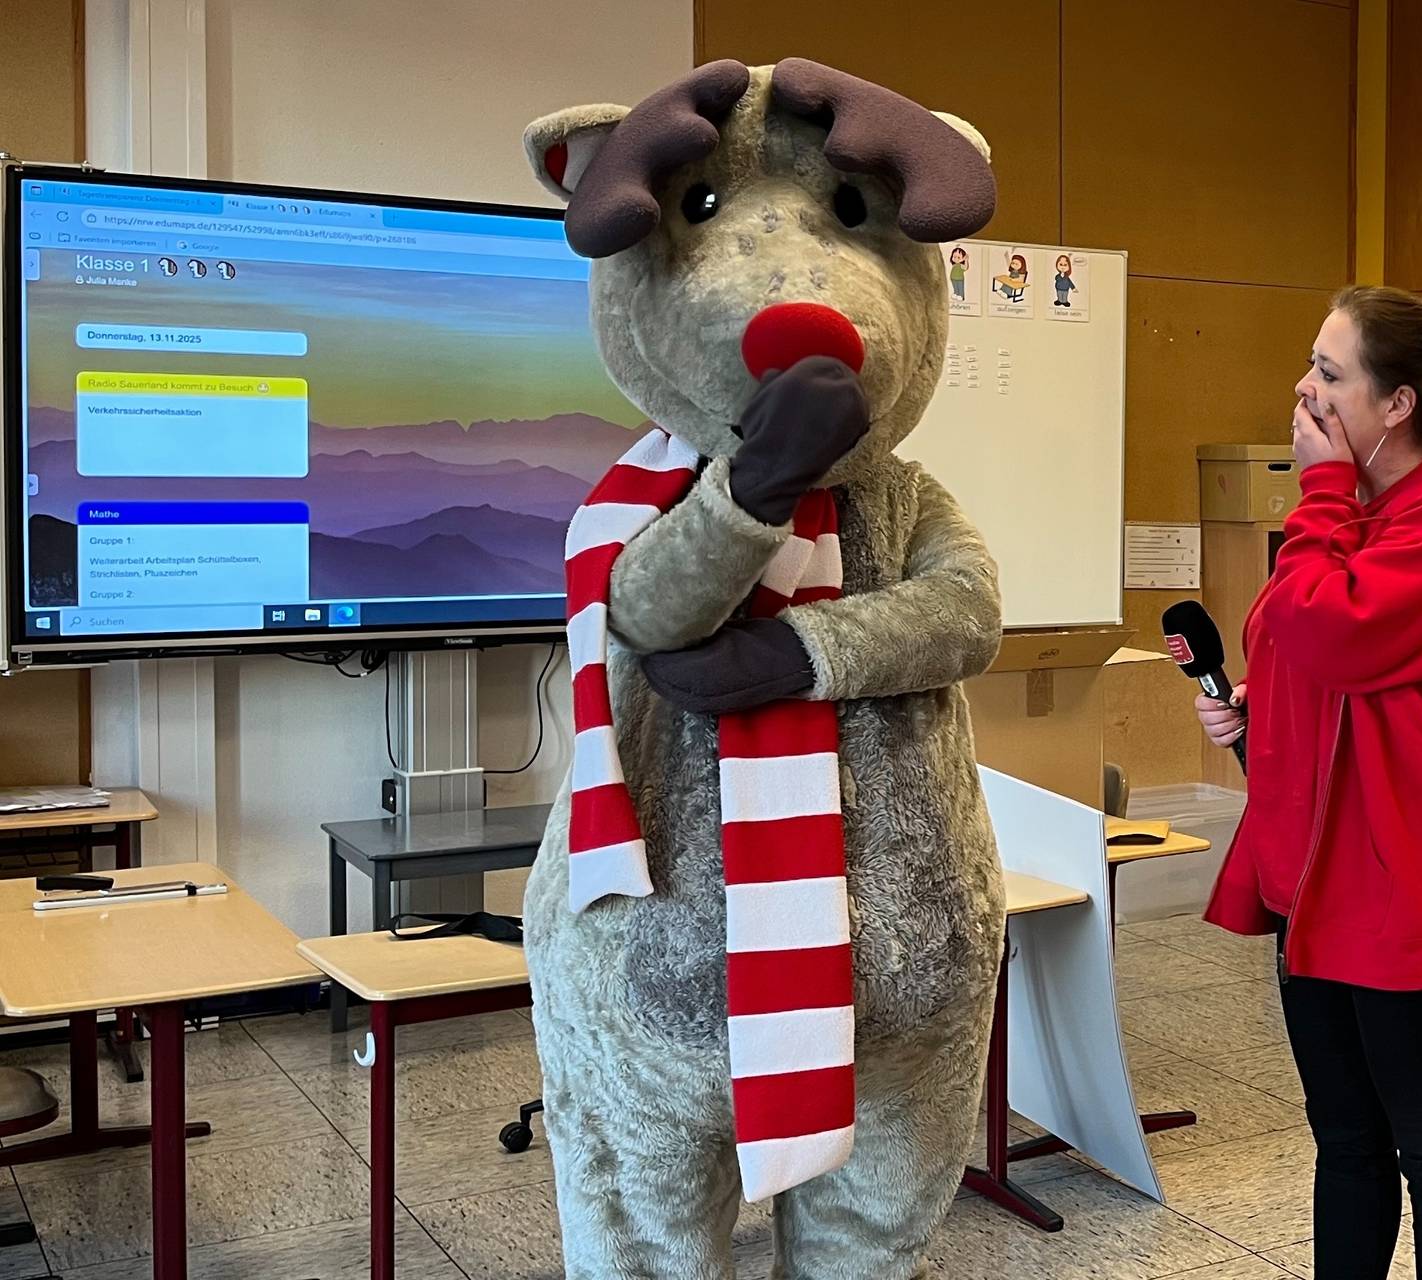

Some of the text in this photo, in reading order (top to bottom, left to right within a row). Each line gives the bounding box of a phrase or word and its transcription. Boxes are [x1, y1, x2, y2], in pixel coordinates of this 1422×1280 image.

[191, 242, 220, 253] Google
[76, 254, 149, 273] Klasse 1
[86, 275, 107, 285] Julia
[87, 330, 202, 344] Donnerstag, 13.11.2025
[88, 379, 117, 389] Radio
[119, 380, 168, 390] Sauerland
[170, 381, 203, 391] kommt
[219, 383, 254, 392] Besuch
[87, 406, 202, 417] Verkehrssicherheitsaktion
[89, 509, 120, 519] Mathe
[89, 536, 135, 546] Gruppe 1:
[89, 554, 262, 567] Weiterarbeit Arbeitsplan Schüttelboxen,
[89, 568, 198, 579] Strichlisten, Pluszeichen
[89, 590, 135, 601] Gruppe 2:
[89, 617, 125, 627] Suchen
